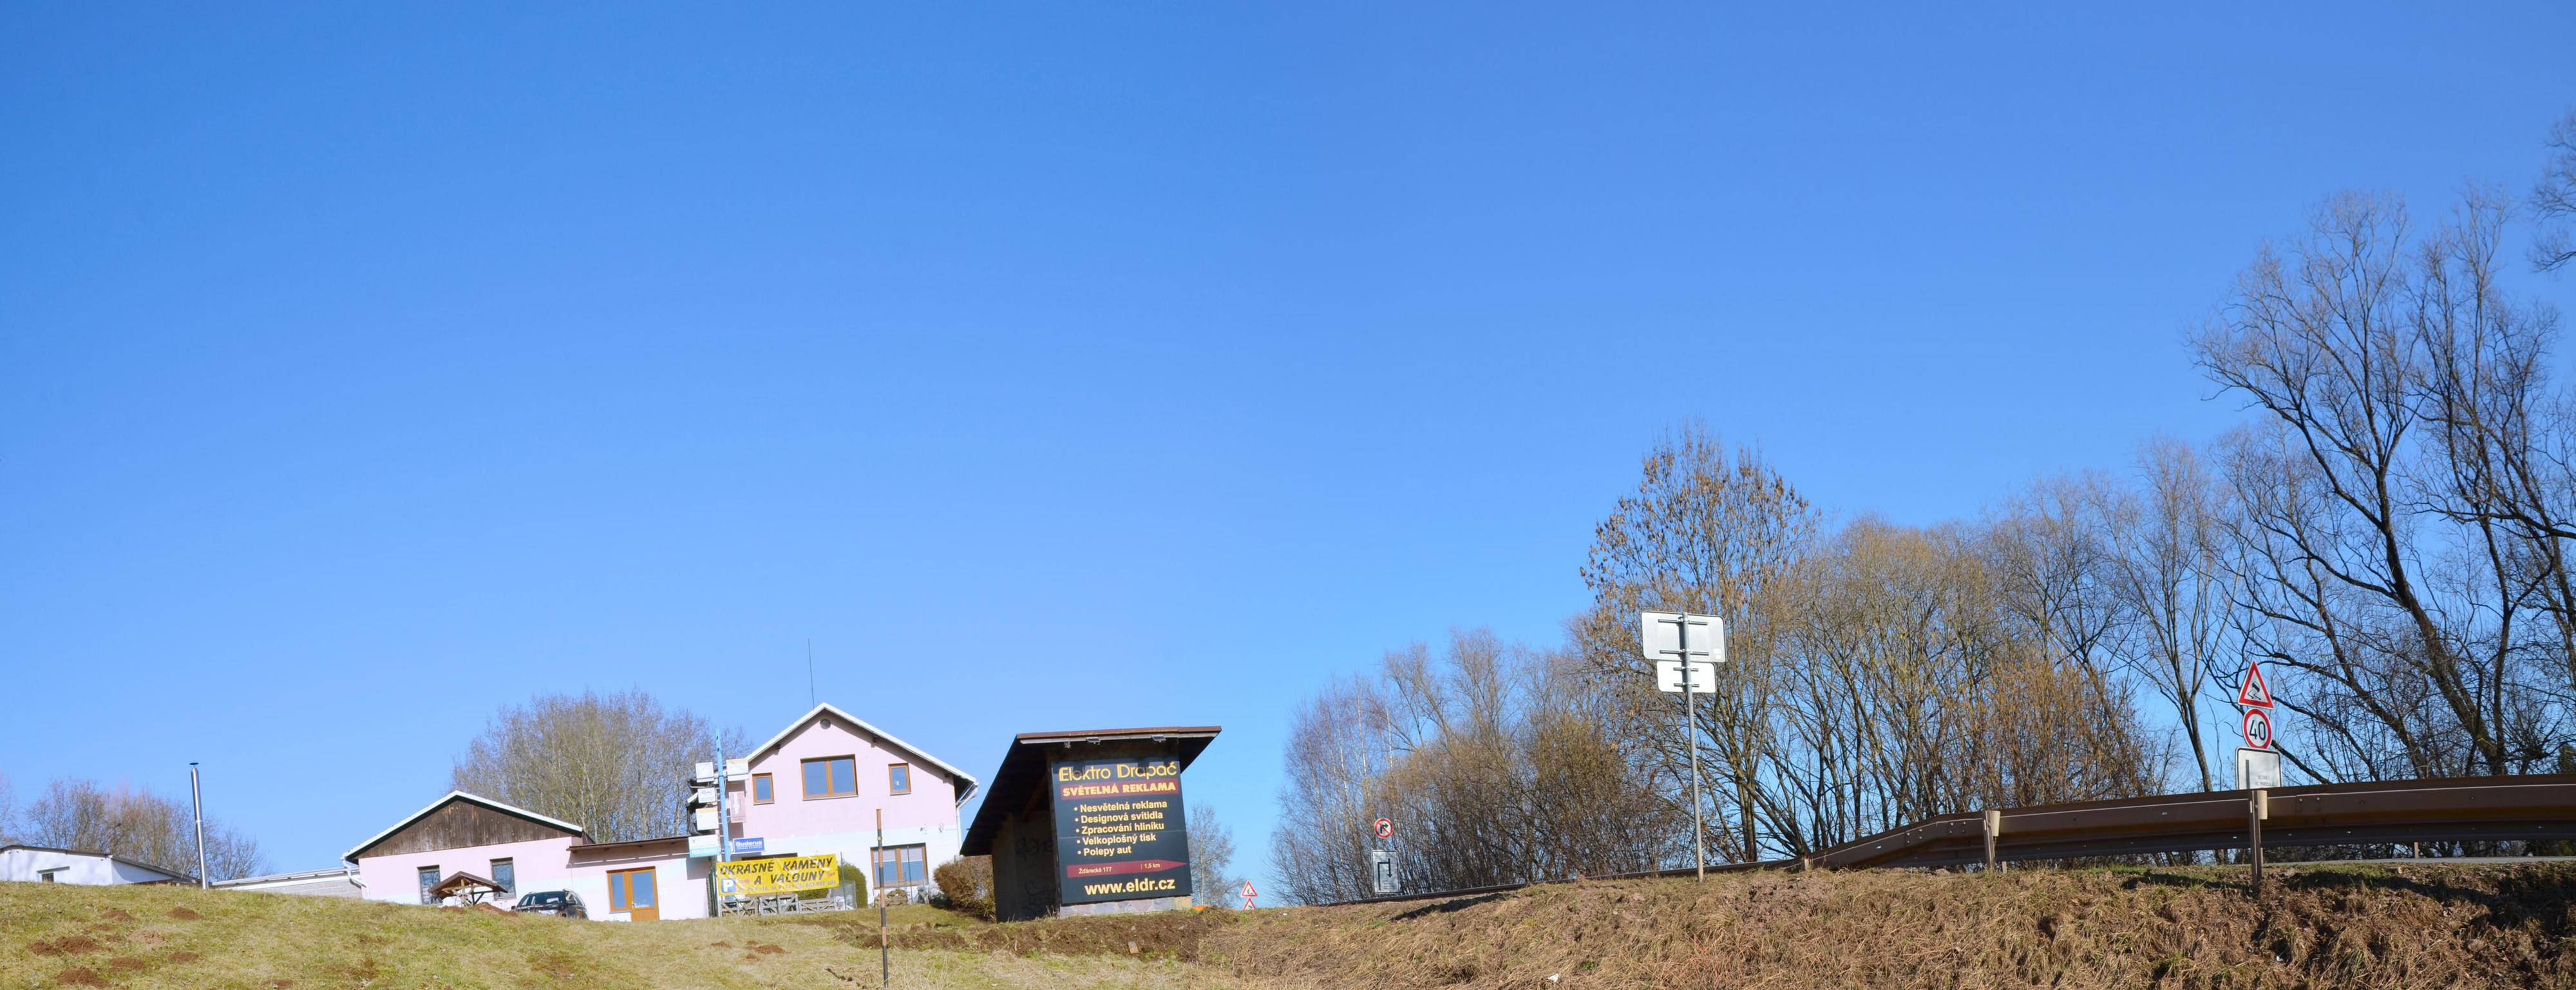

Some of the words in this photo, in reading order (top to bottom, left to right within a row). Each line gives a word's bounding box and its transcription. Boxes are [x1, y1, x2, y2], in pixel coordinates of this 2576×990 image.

[2249, 719, 2266, 741] 40
[1059, 765, 1111, 781] Elektro
[1117, 761, 1177, 779] Drapač
[1063, 783, 1119, 797] SVĚTELNÁ
[1122, 782, 1177, 793] REKLAMA
[1080, 801, 1130, 813] Nesvětelná
[1132, 801, 1168, 810] reklama
[1081, 812, 1129, 824] Designová
[1131, 811, 1164, 820] svítidla
[1081, 823, 1132, 835] Zpracování
[1134, 822, 1165, 831] hliníku
[1083, 833, 1137, 846] Velkoplošný
[1139, 833, 1157, 842] tisk
[1083, 847, 1115, 857] Polepy
[1117, 845, 1132, 854] aut
[720, 860, 775, 875] OKRASNÉ
[782, 857, 833, 871] KAMENY
[753, 875, 761, 886] A
[770, 871, 825, 884] VALOUNY
[1084, 878, 1175, 895] www.eldr.cz
